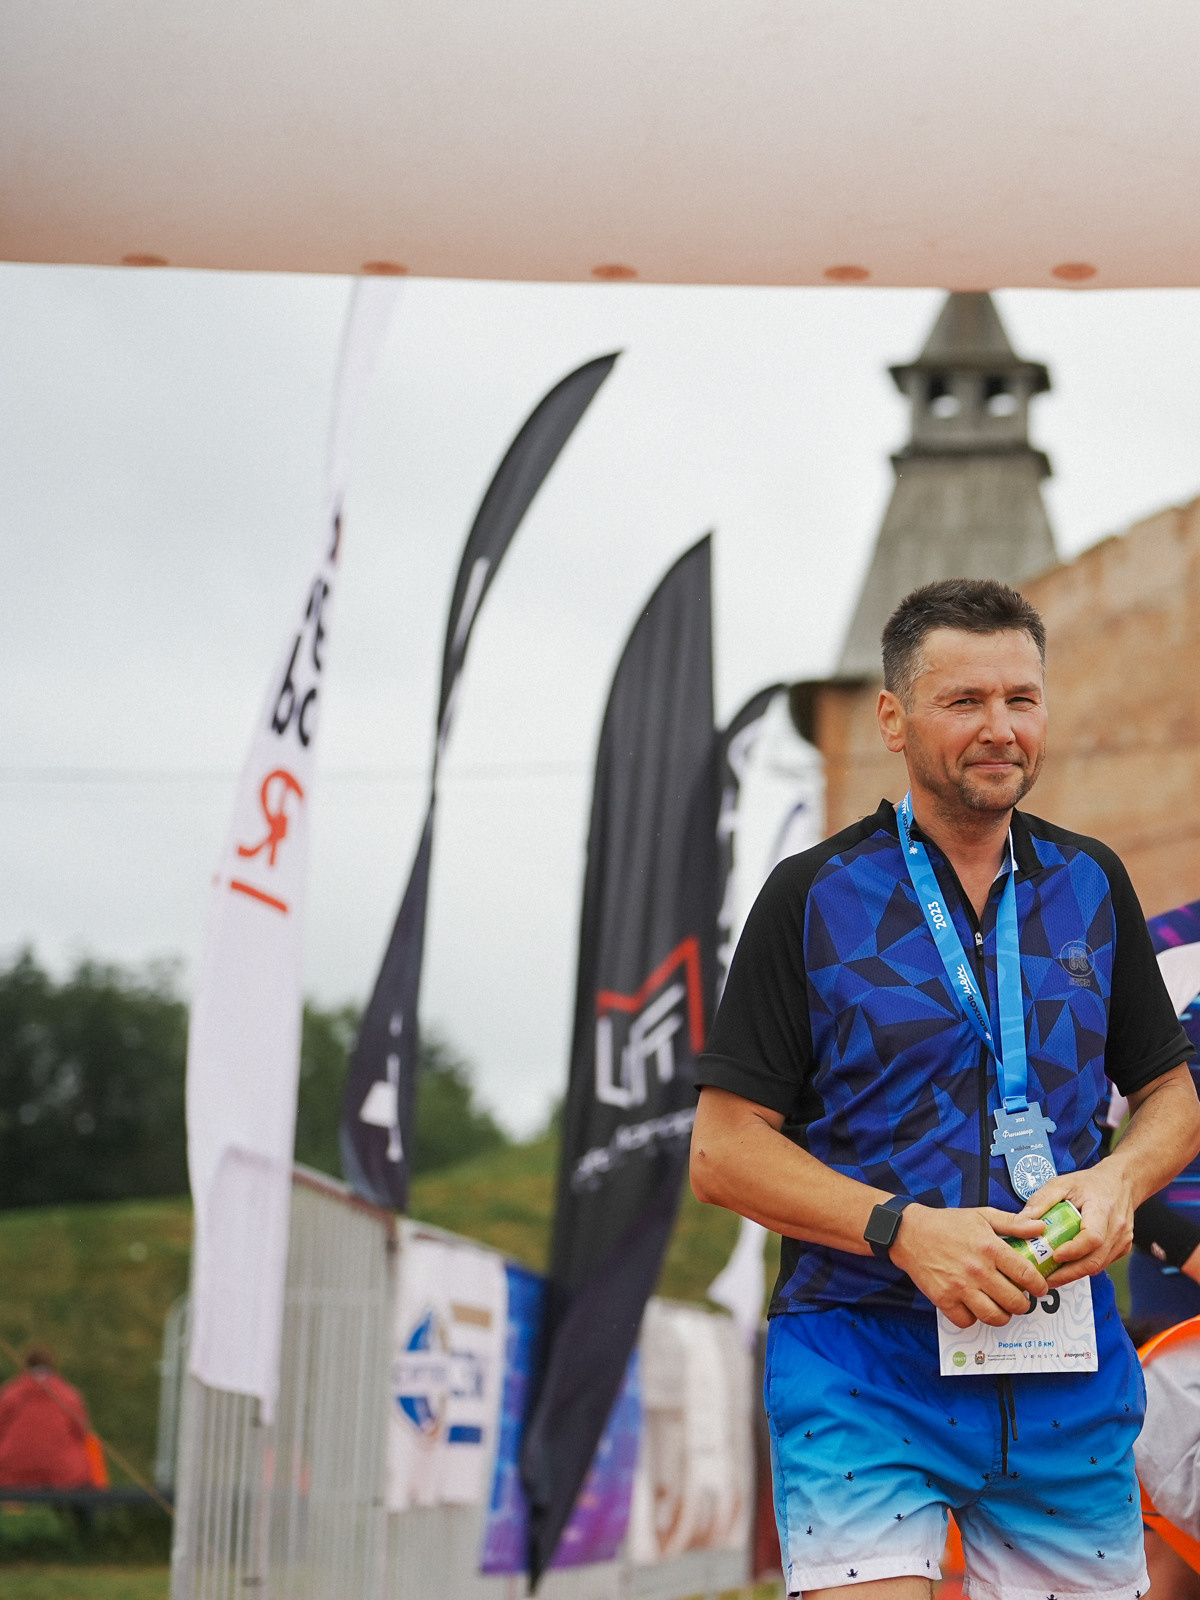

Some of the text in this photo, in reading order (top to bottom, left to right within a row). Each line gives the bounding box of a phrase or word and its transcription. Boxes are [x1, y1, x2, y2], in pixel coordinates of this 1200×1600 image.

[927, 901, 947, 930] 2023
[1002, 1128, 1034, 1139] Финишер
[998, 1341, 1023, 1349] Рюрик
